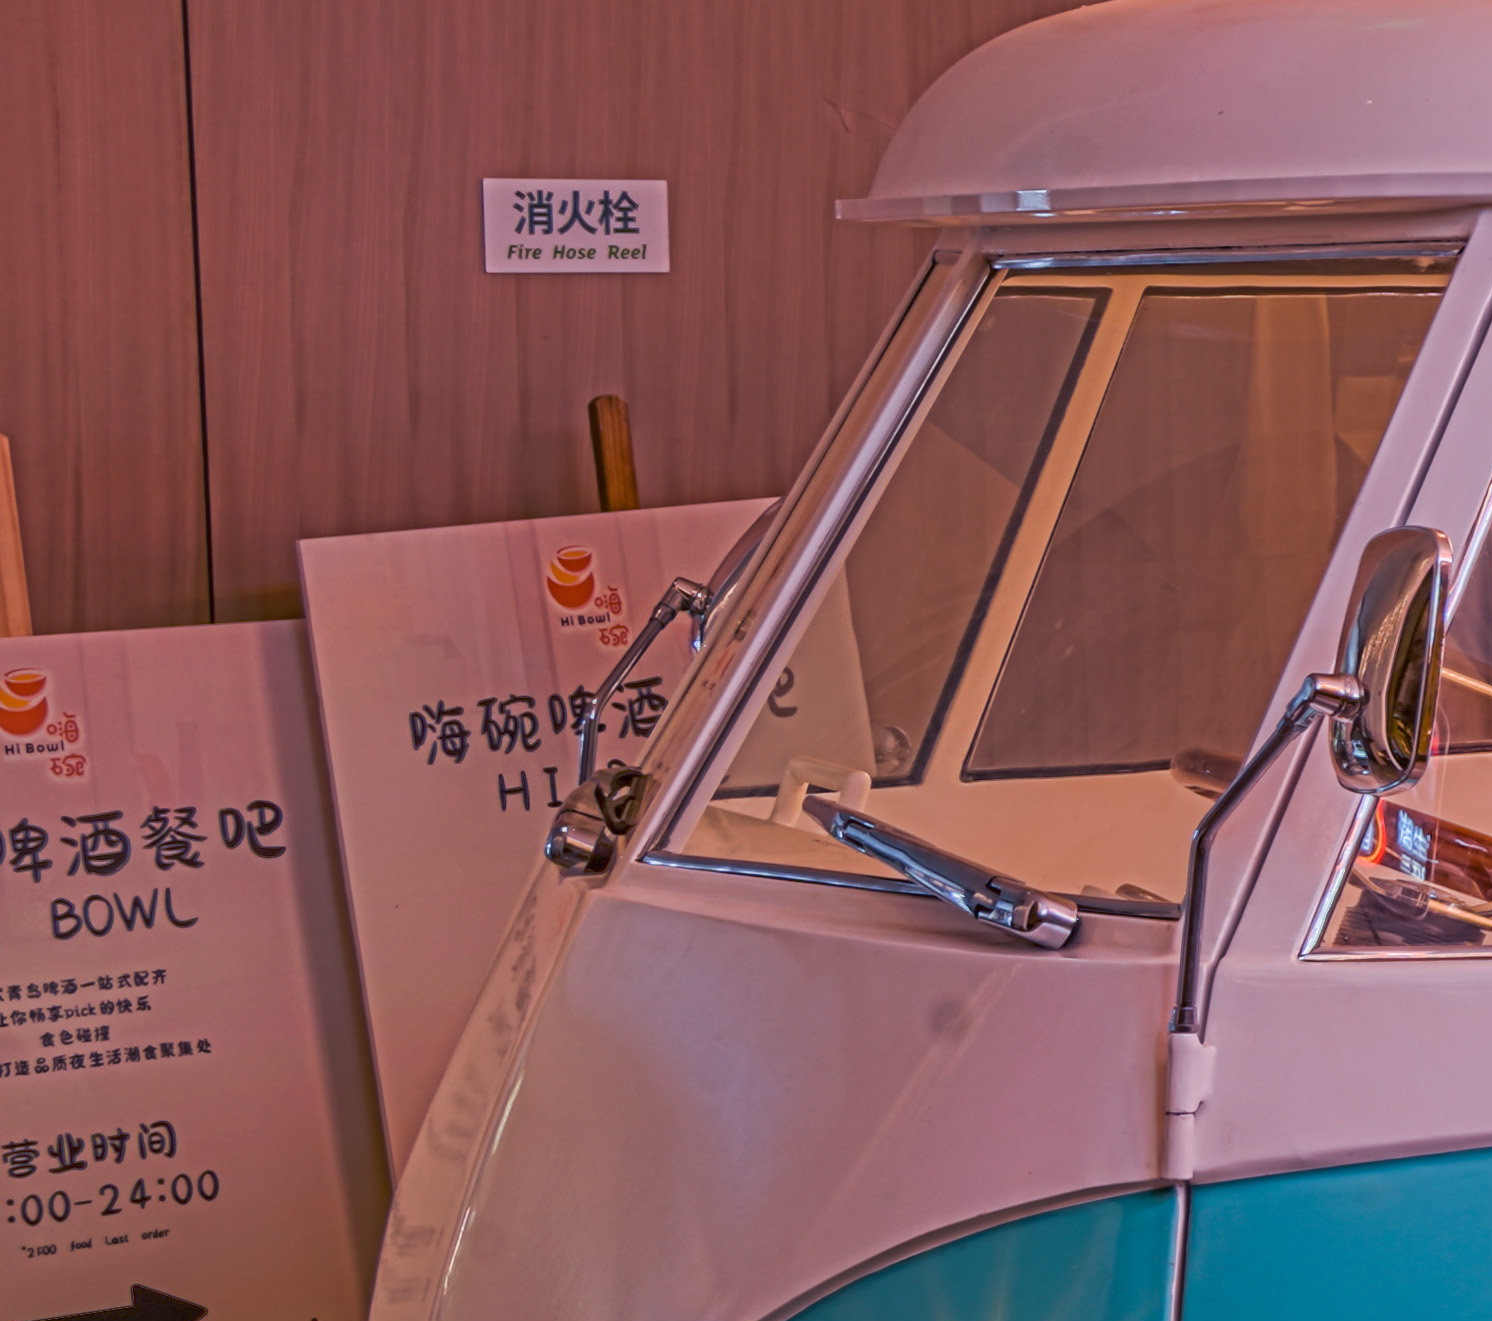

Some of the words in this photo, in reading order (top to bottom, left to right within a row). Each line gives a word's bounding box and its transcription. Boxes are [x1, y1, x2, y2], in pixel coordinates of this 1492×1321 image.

[512, 189, 641, 236] 消火栓
[506, 243, 543, 260] Fire
[552, 244, 597, 260] Hose
[607, 243, 648, 260] Reel
[560, 615, 575, 627] Hi
[578, 611, 611, 626] Bowl
[4, 742, 21, 756] Hi
[25, 740, 66, 754] Bowl
[50, 886, 199, 941] BOWL
[40, 1025, 111, 1048] 食色碰撞
[1, 1119, 178, 1179] 营业时间
